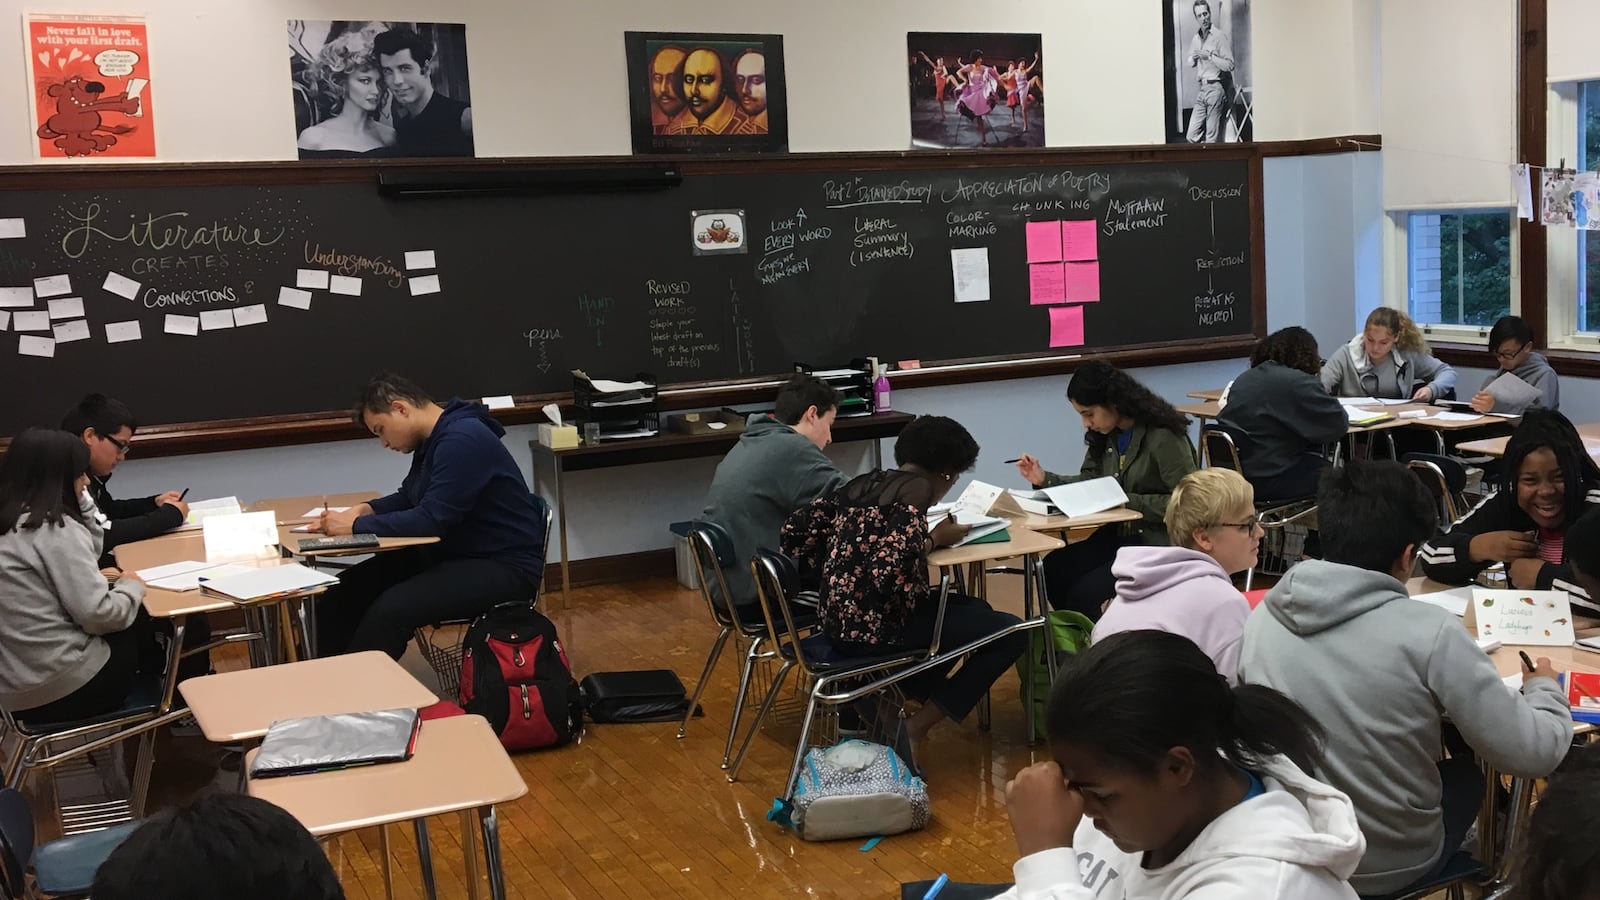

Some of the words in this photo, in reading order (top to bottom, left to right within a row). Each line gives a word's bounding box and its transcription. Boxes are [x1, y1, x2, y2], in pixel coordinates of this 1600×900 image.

[46, 26, 75, 36] Never
[77, 26, 95, 36] fall
[98, 27, 109, 36] in
[110, 27, 131, 36] love
[37, 35, 63, 45] with
[64, 36, 89, 47] your
[90, 36, 113, 45] first
[114, 37, 143, 47] draft.
[822, 180, 844, 202] Part
[845, 181, 852, 199] 2
[1188, 184, 1243, 201] DISCUSSION
[62, 203, 284, 259] Literature
[771, 219, 796, 232] LOOK
[948, 222, 998, 238] MARKING
[764, 232, 795, 252] EVERY
[798, 226, 832, 242] WORD
[853, 231, 908, 248] Summary
[131, 253, 229, 275] CREATES
[654, 297, 685, 307] WORK
[649, 318, 673, 330] Staple
[677, 318, 697, 330] your
[672, 330, 693, 341] draft
[650, 345, 664, 358] top
[667, 345, 677, 353] of
[678, 344, 690, 353] the
[666, 355, 701, 368] draft(s)
